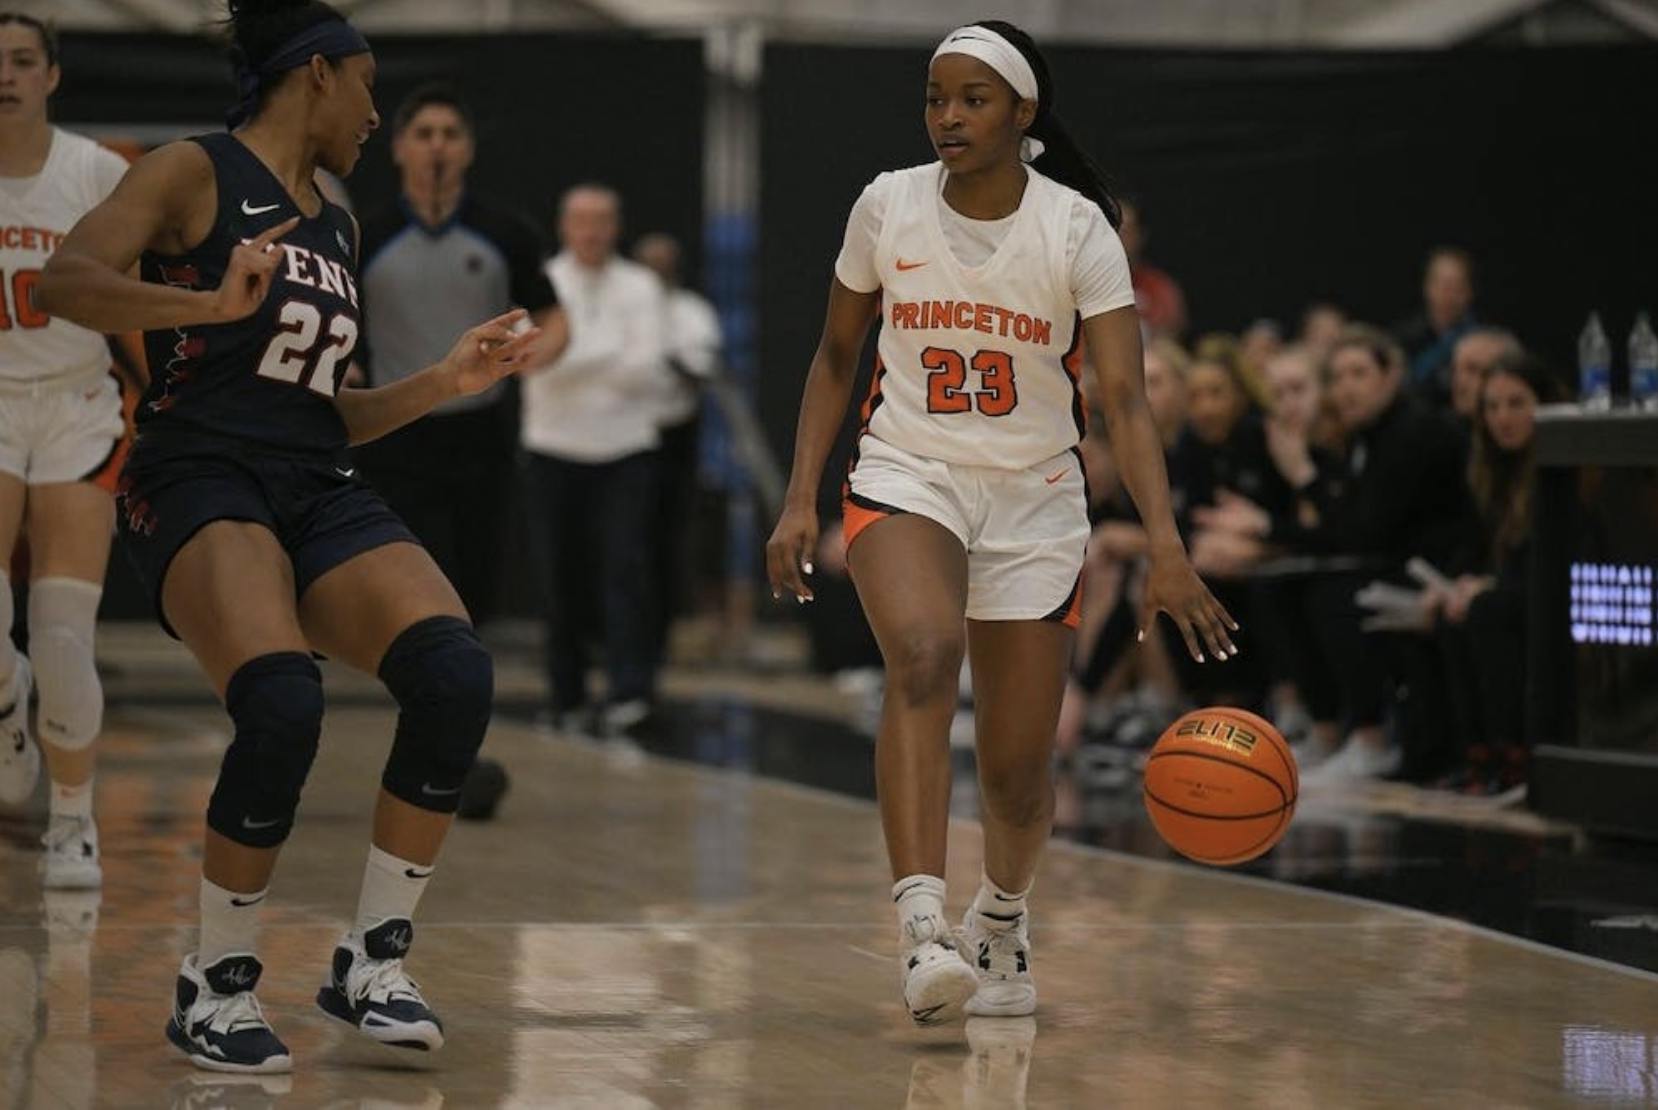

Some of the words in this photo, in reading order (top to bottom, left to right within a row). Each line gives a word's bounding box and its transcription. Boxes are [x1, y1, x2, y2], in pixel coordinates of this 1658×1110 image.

[241, 238, 359, 309] ENN
[256, 300, 359, 398] 22
[892, 300, 1052, 345] PRINCETON
[921, 346, 1017, 416] 23
